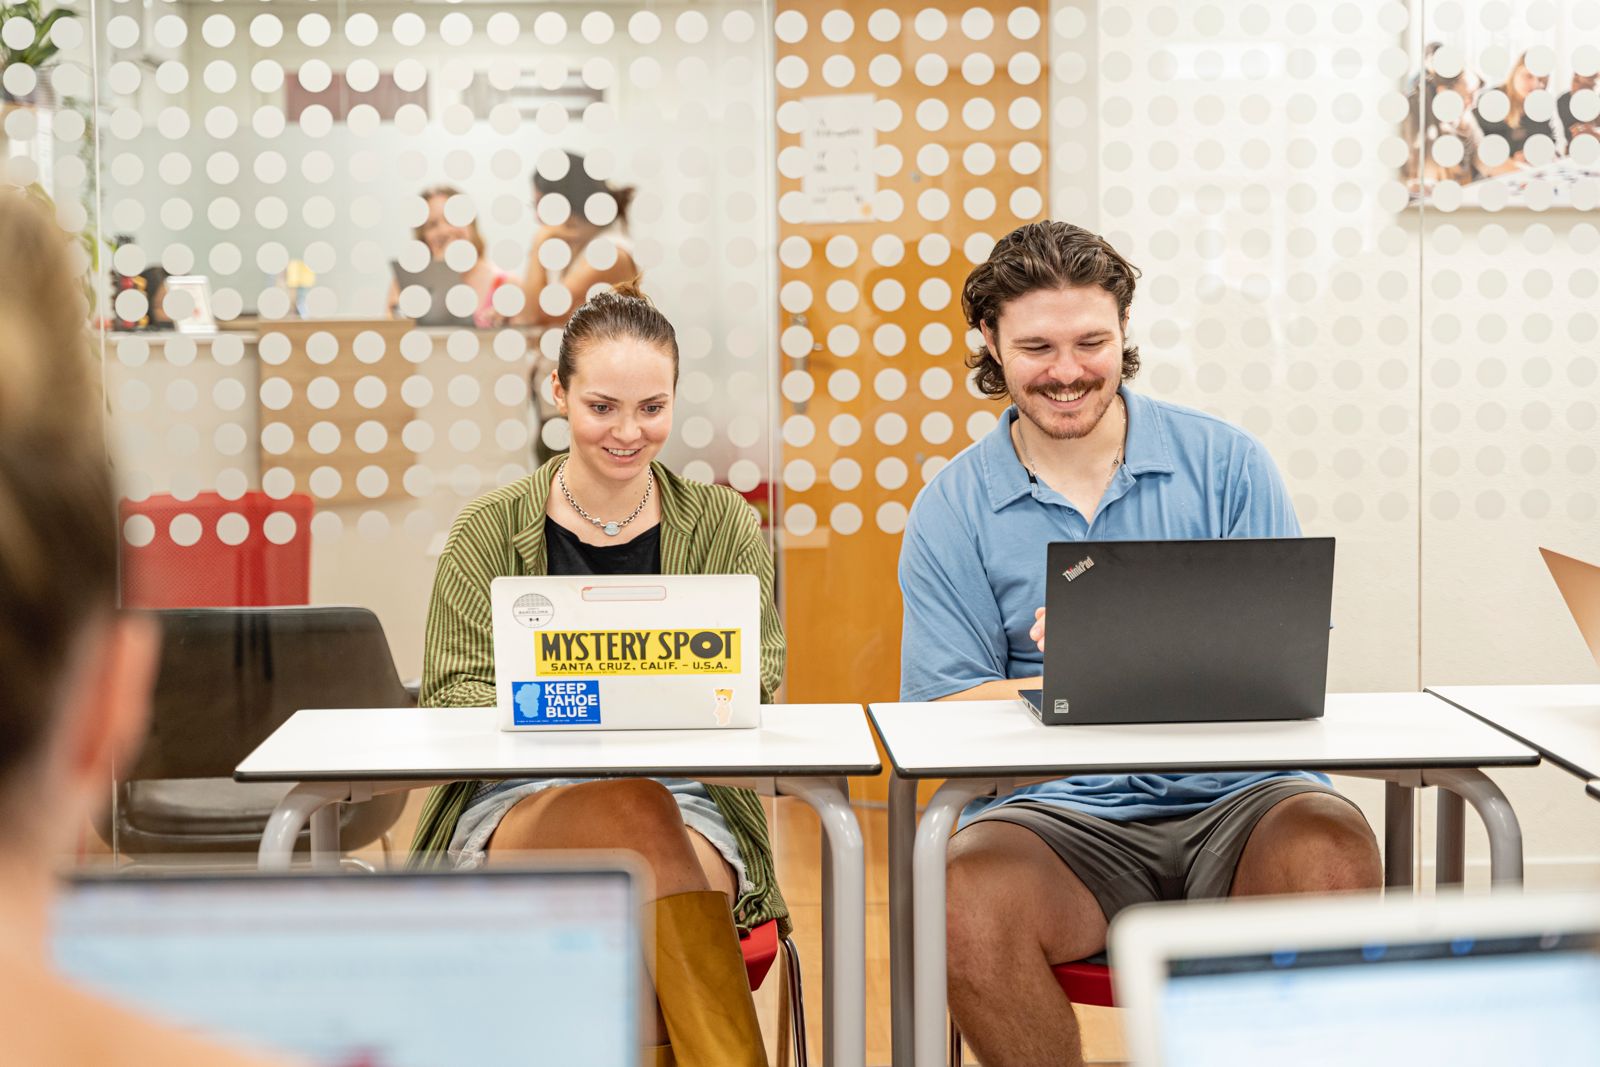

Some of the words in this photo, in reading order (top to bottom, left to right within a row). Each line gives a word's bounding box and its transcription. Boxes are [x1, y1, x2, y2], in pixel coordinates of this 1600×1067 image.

[1062, 555, 1095, 582] ThinkPad
[541, 632, 651, 661] MYSTERY
[658, 630, 736, 659] SPOT
[551, 662, 593, 671] SANTA
[640, 661, 678, 670] CALIF.
[692, 661, 728, 670] U.S.A.
[544, 682, 587, 695] KEEP
[544, 694, 598, 707] TAHOE
[545, 706, 588, 718] BLUE
